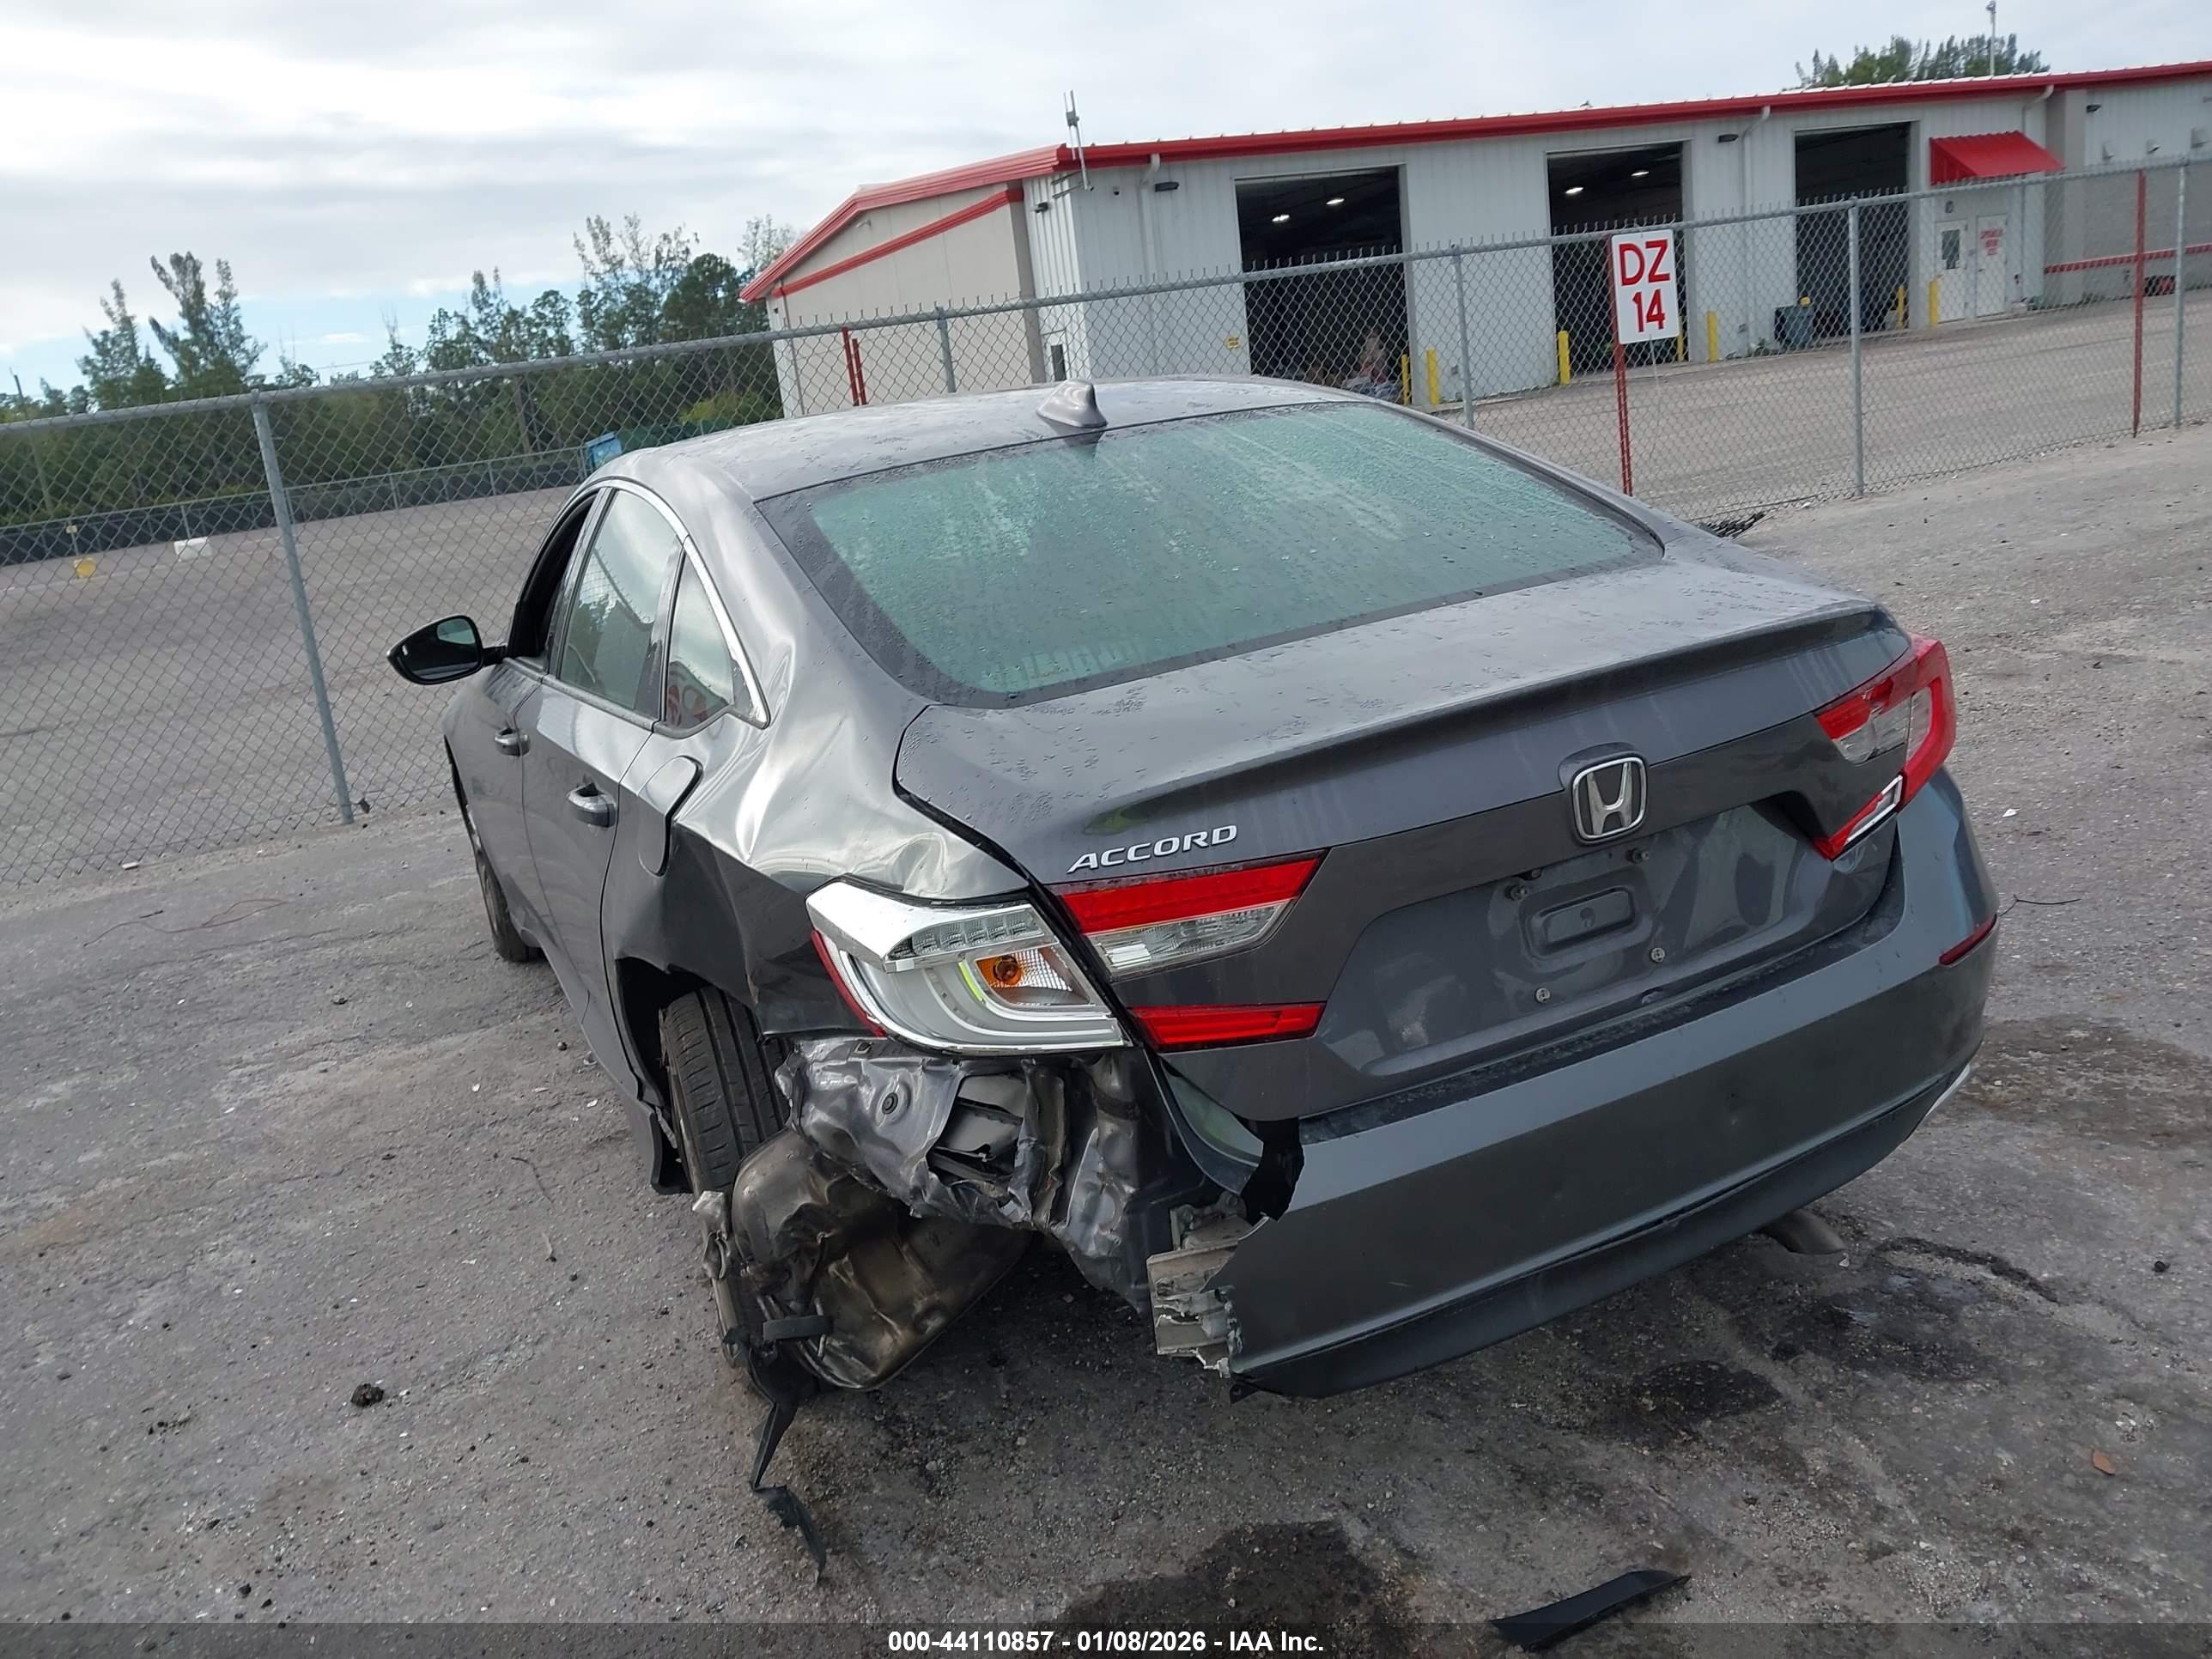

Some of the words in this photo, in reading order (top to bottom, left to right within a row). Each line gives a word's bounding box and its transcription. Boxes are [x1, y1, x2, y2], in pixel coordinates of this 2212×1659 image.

[1619, 240, 1670, 286] DZ
[1632, 289, 1665, 332] 14
[1066, 825, 1237, 874] ACCORD
